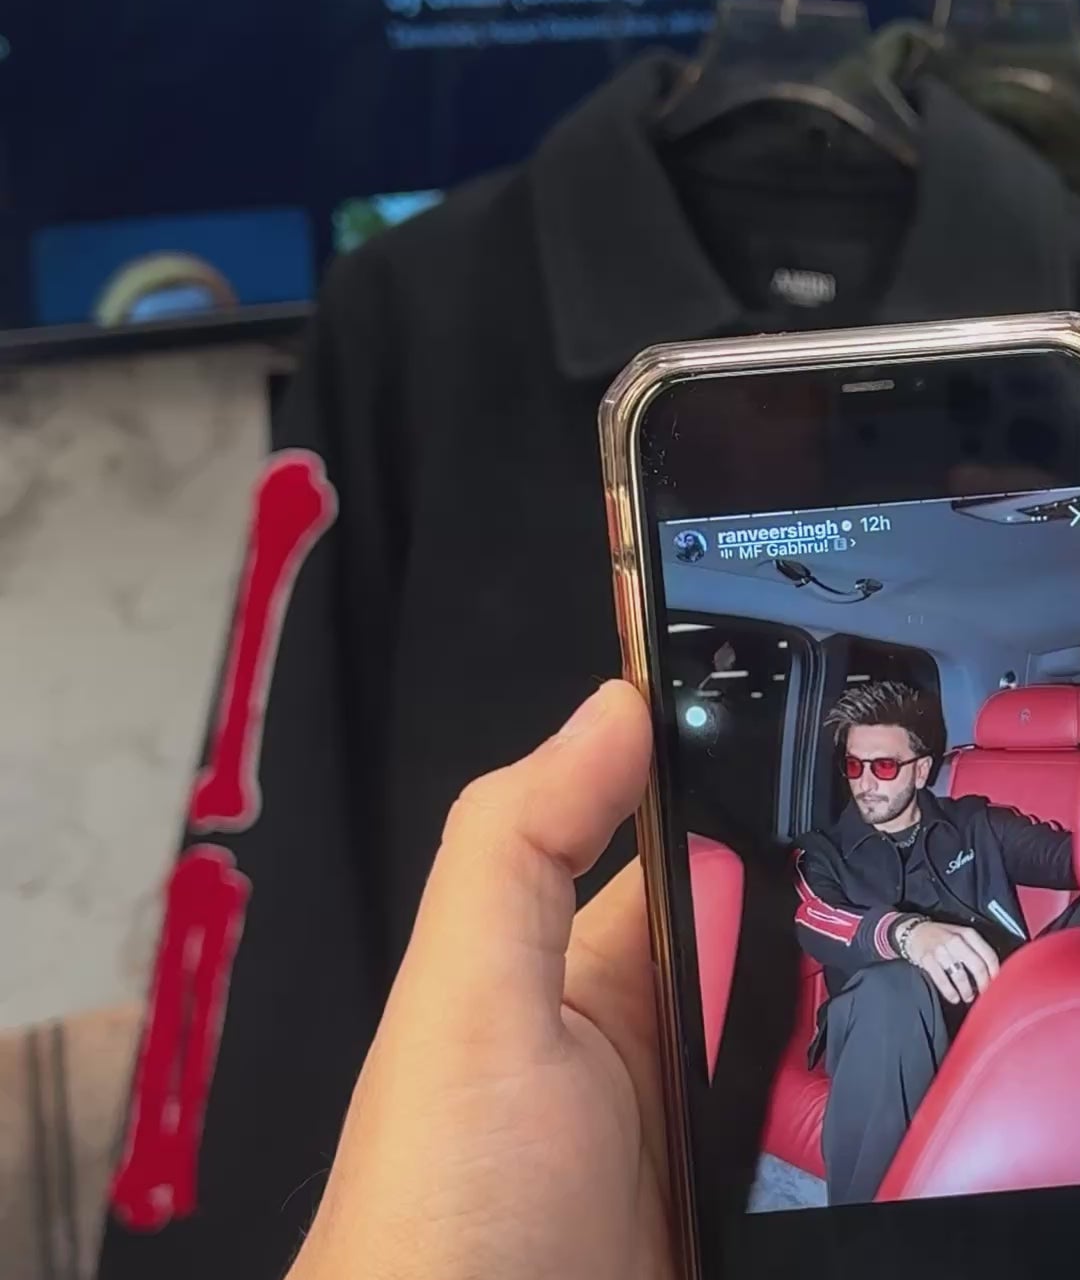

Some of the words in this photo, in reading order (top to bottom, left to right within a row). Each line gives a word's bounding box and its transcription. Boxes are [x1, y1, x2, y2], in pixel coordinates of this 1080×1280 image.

[718, 519, 838, 545] ranveersingh
[860, 515, 891, 533] 12h
[739, 545, 763, 560] MF
[766, 539, 829, 557] Gabhru!
